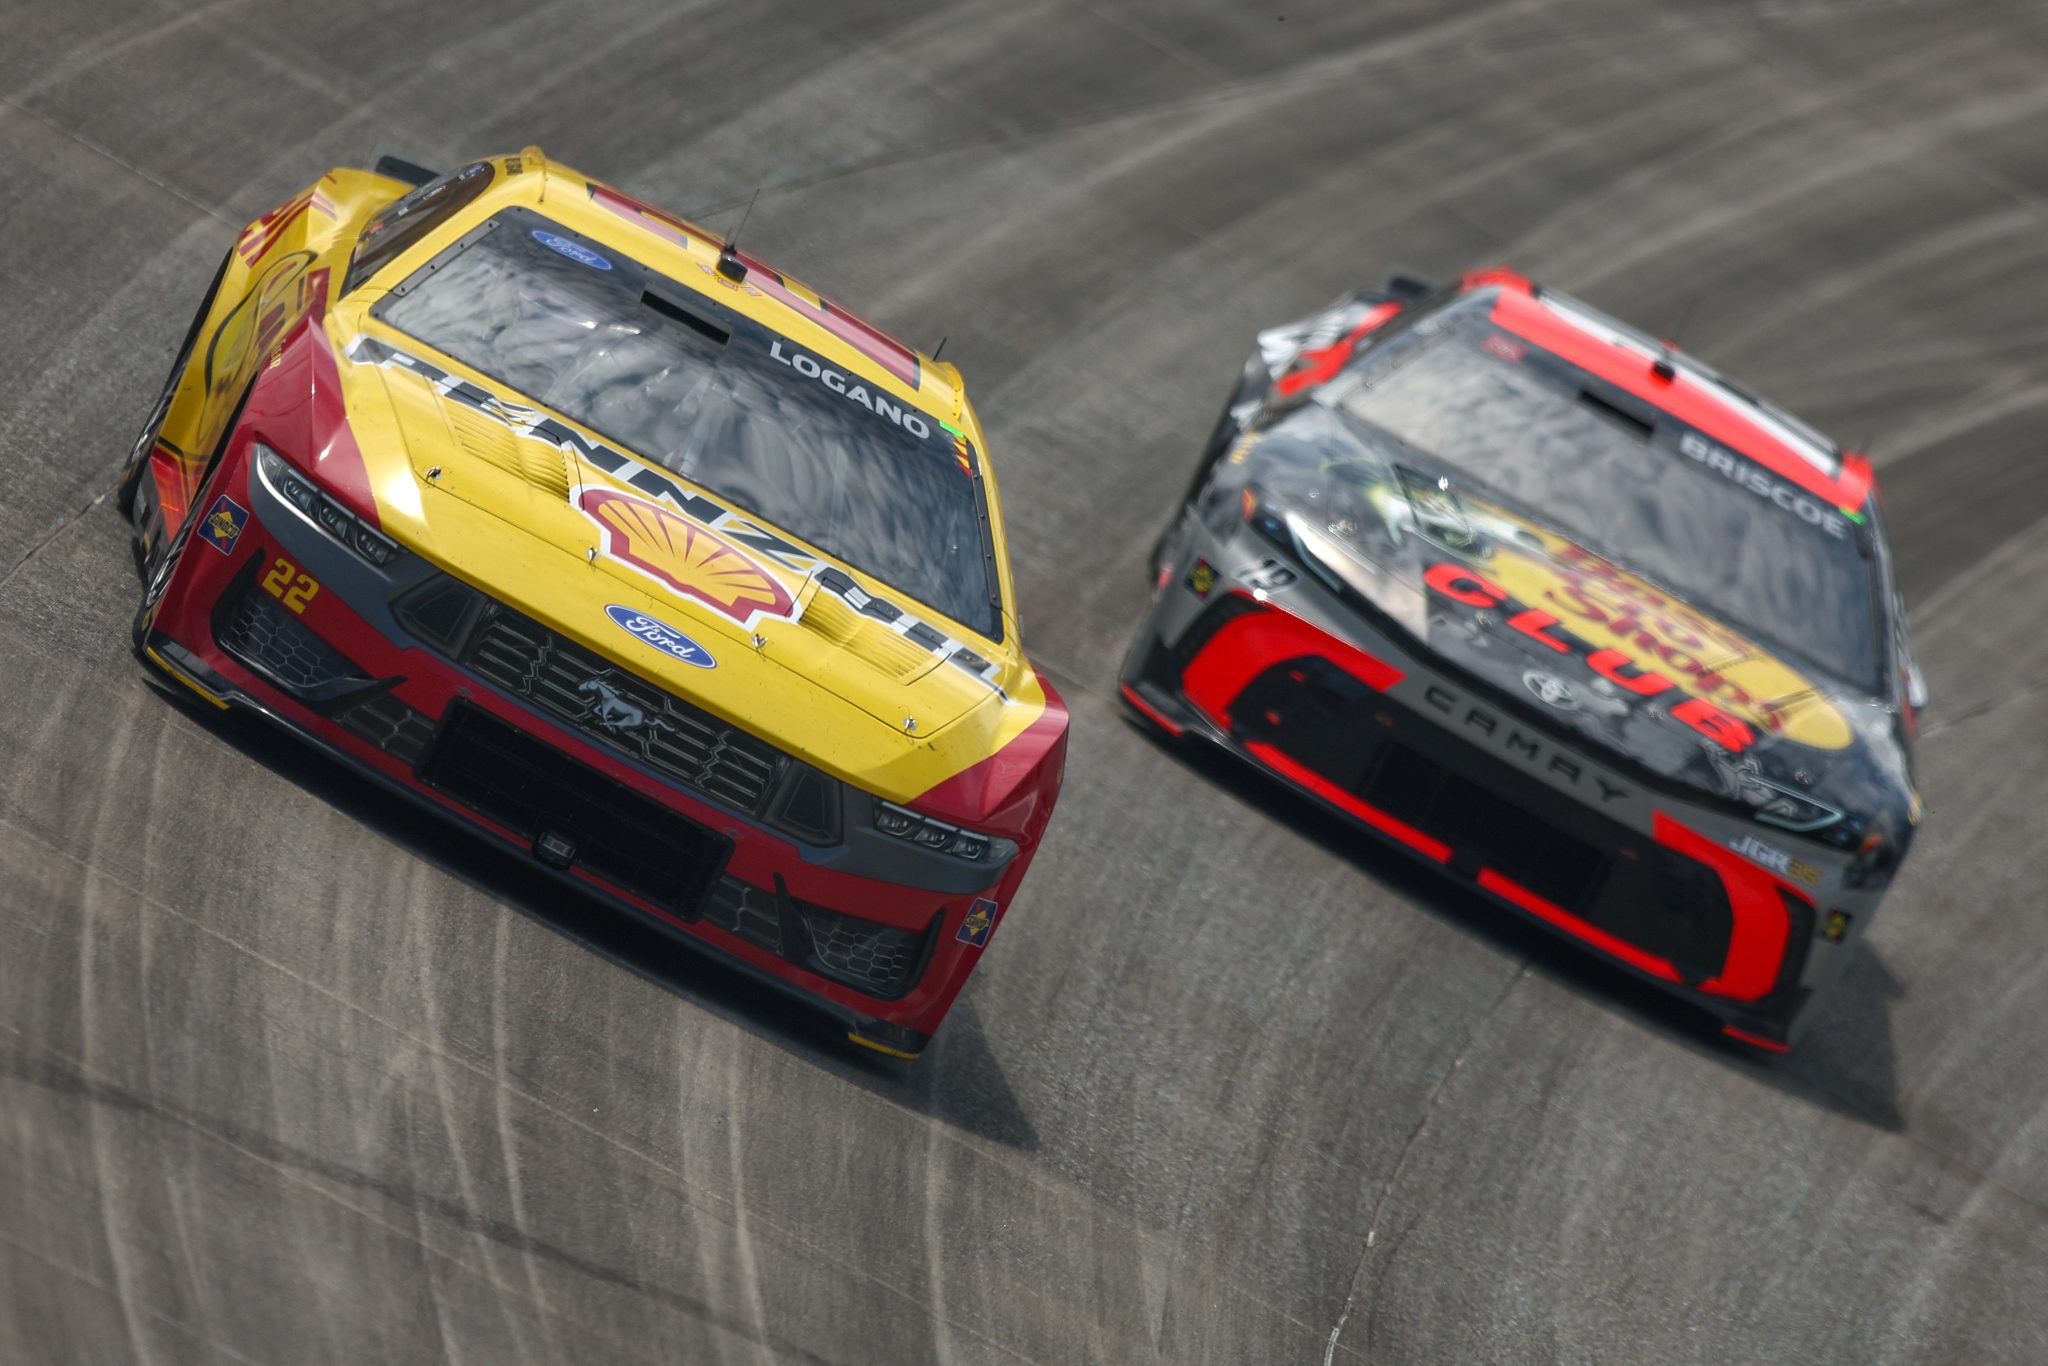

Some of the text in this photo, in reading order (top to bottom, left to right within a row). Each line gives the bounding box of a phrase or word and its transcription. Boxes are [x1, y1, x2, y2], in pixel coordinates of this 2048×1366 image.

[546, 238, 597, 264] Ford
[769, 340, 930, 440] LOGANO
[1679, 429, 1848, 540] BRISCOE
[208, 512, 239, 539] SUNOCO
[262, 557, 320, 615] 22
[625, 615, 697, 658] Ford
[1423, 563, 1757, 753] CLUB
